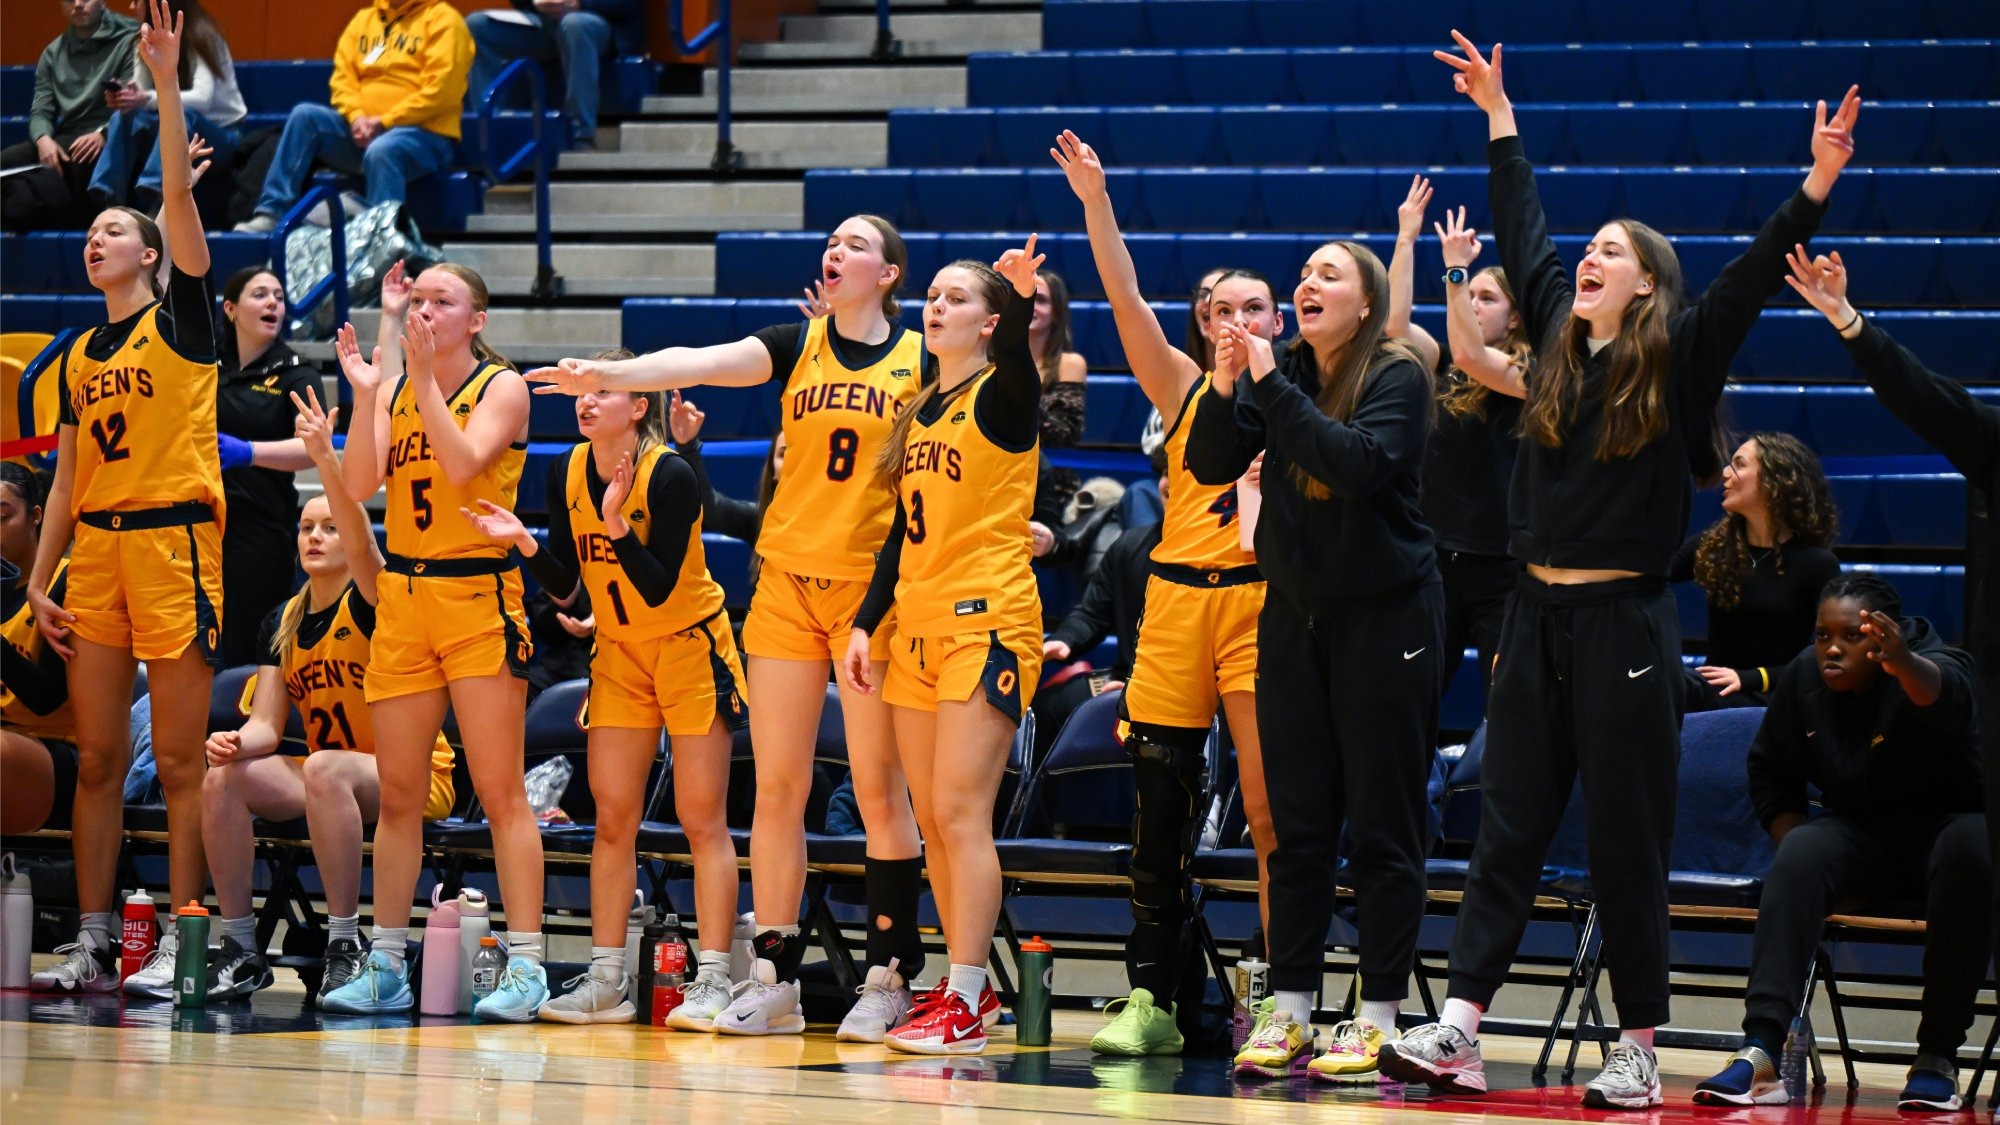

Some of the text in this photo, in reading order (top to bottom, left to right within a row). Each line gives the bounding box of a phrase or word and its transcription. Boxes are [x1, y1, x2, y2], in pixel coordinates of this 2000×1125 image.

[90, 411, 130, 464] 12
[826, 427, 859, 482] 8
[899, 440, 962, 483] EEN'S
[410, 477, 433, 532] 5
[907, 489, 926, 545] 3
[1207, 481, 1239, 529] 4
[606, 580, 630, 626] 1
[286, 659, 366, 701] QUEEN'S
[997, 669, 1016, 697] Q
[310, 701, 357, 751] 21
[123, 919, 149, 932] BIO
[473, 972, 483, 984] G
